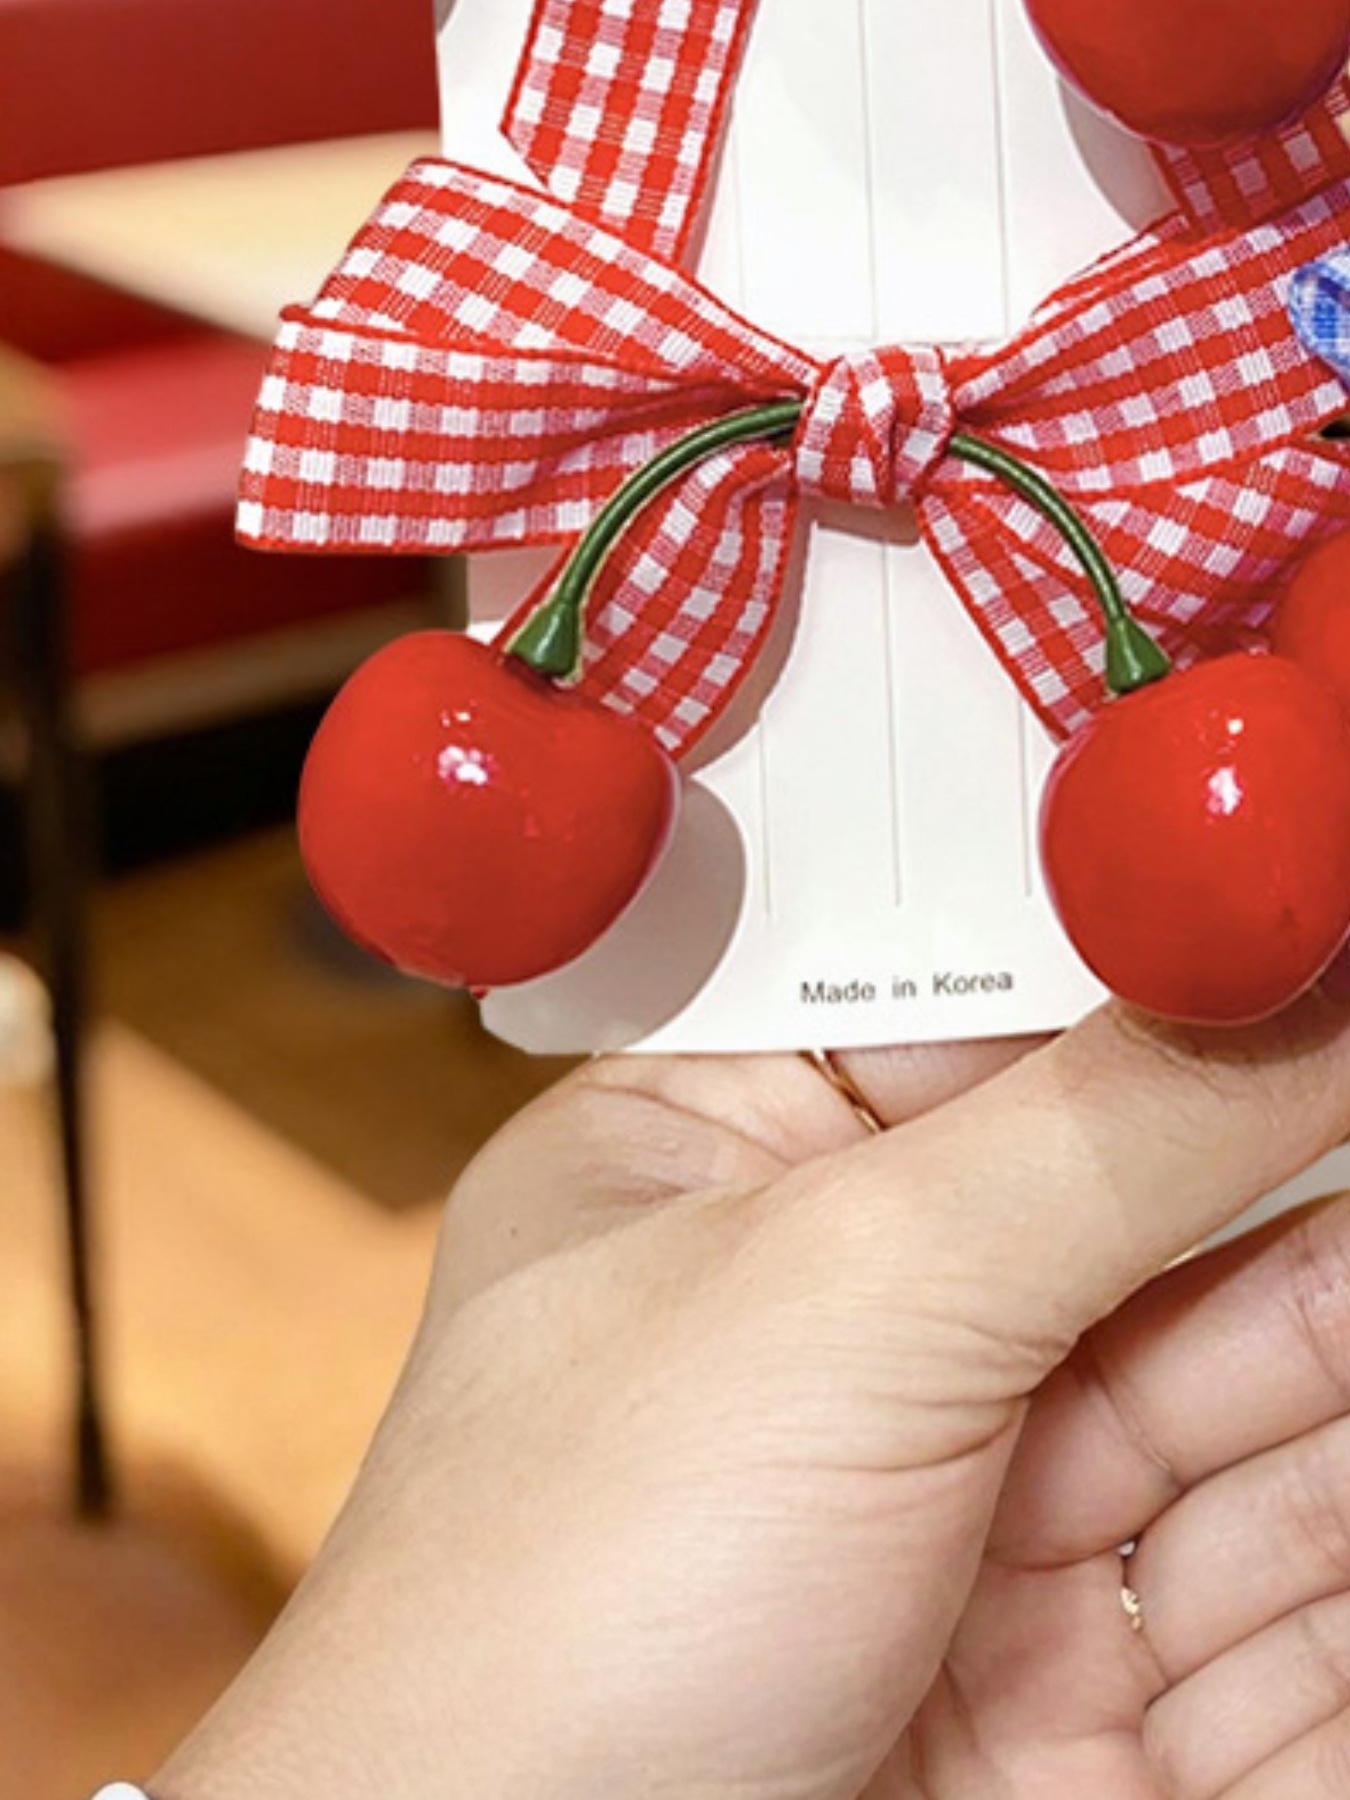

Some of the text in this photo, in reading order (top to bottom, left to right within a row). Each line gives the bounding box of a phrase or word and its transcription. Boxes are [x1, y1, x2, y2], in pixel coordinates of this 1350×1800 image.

[799, 969, 1014, 1004] Made in Korea
